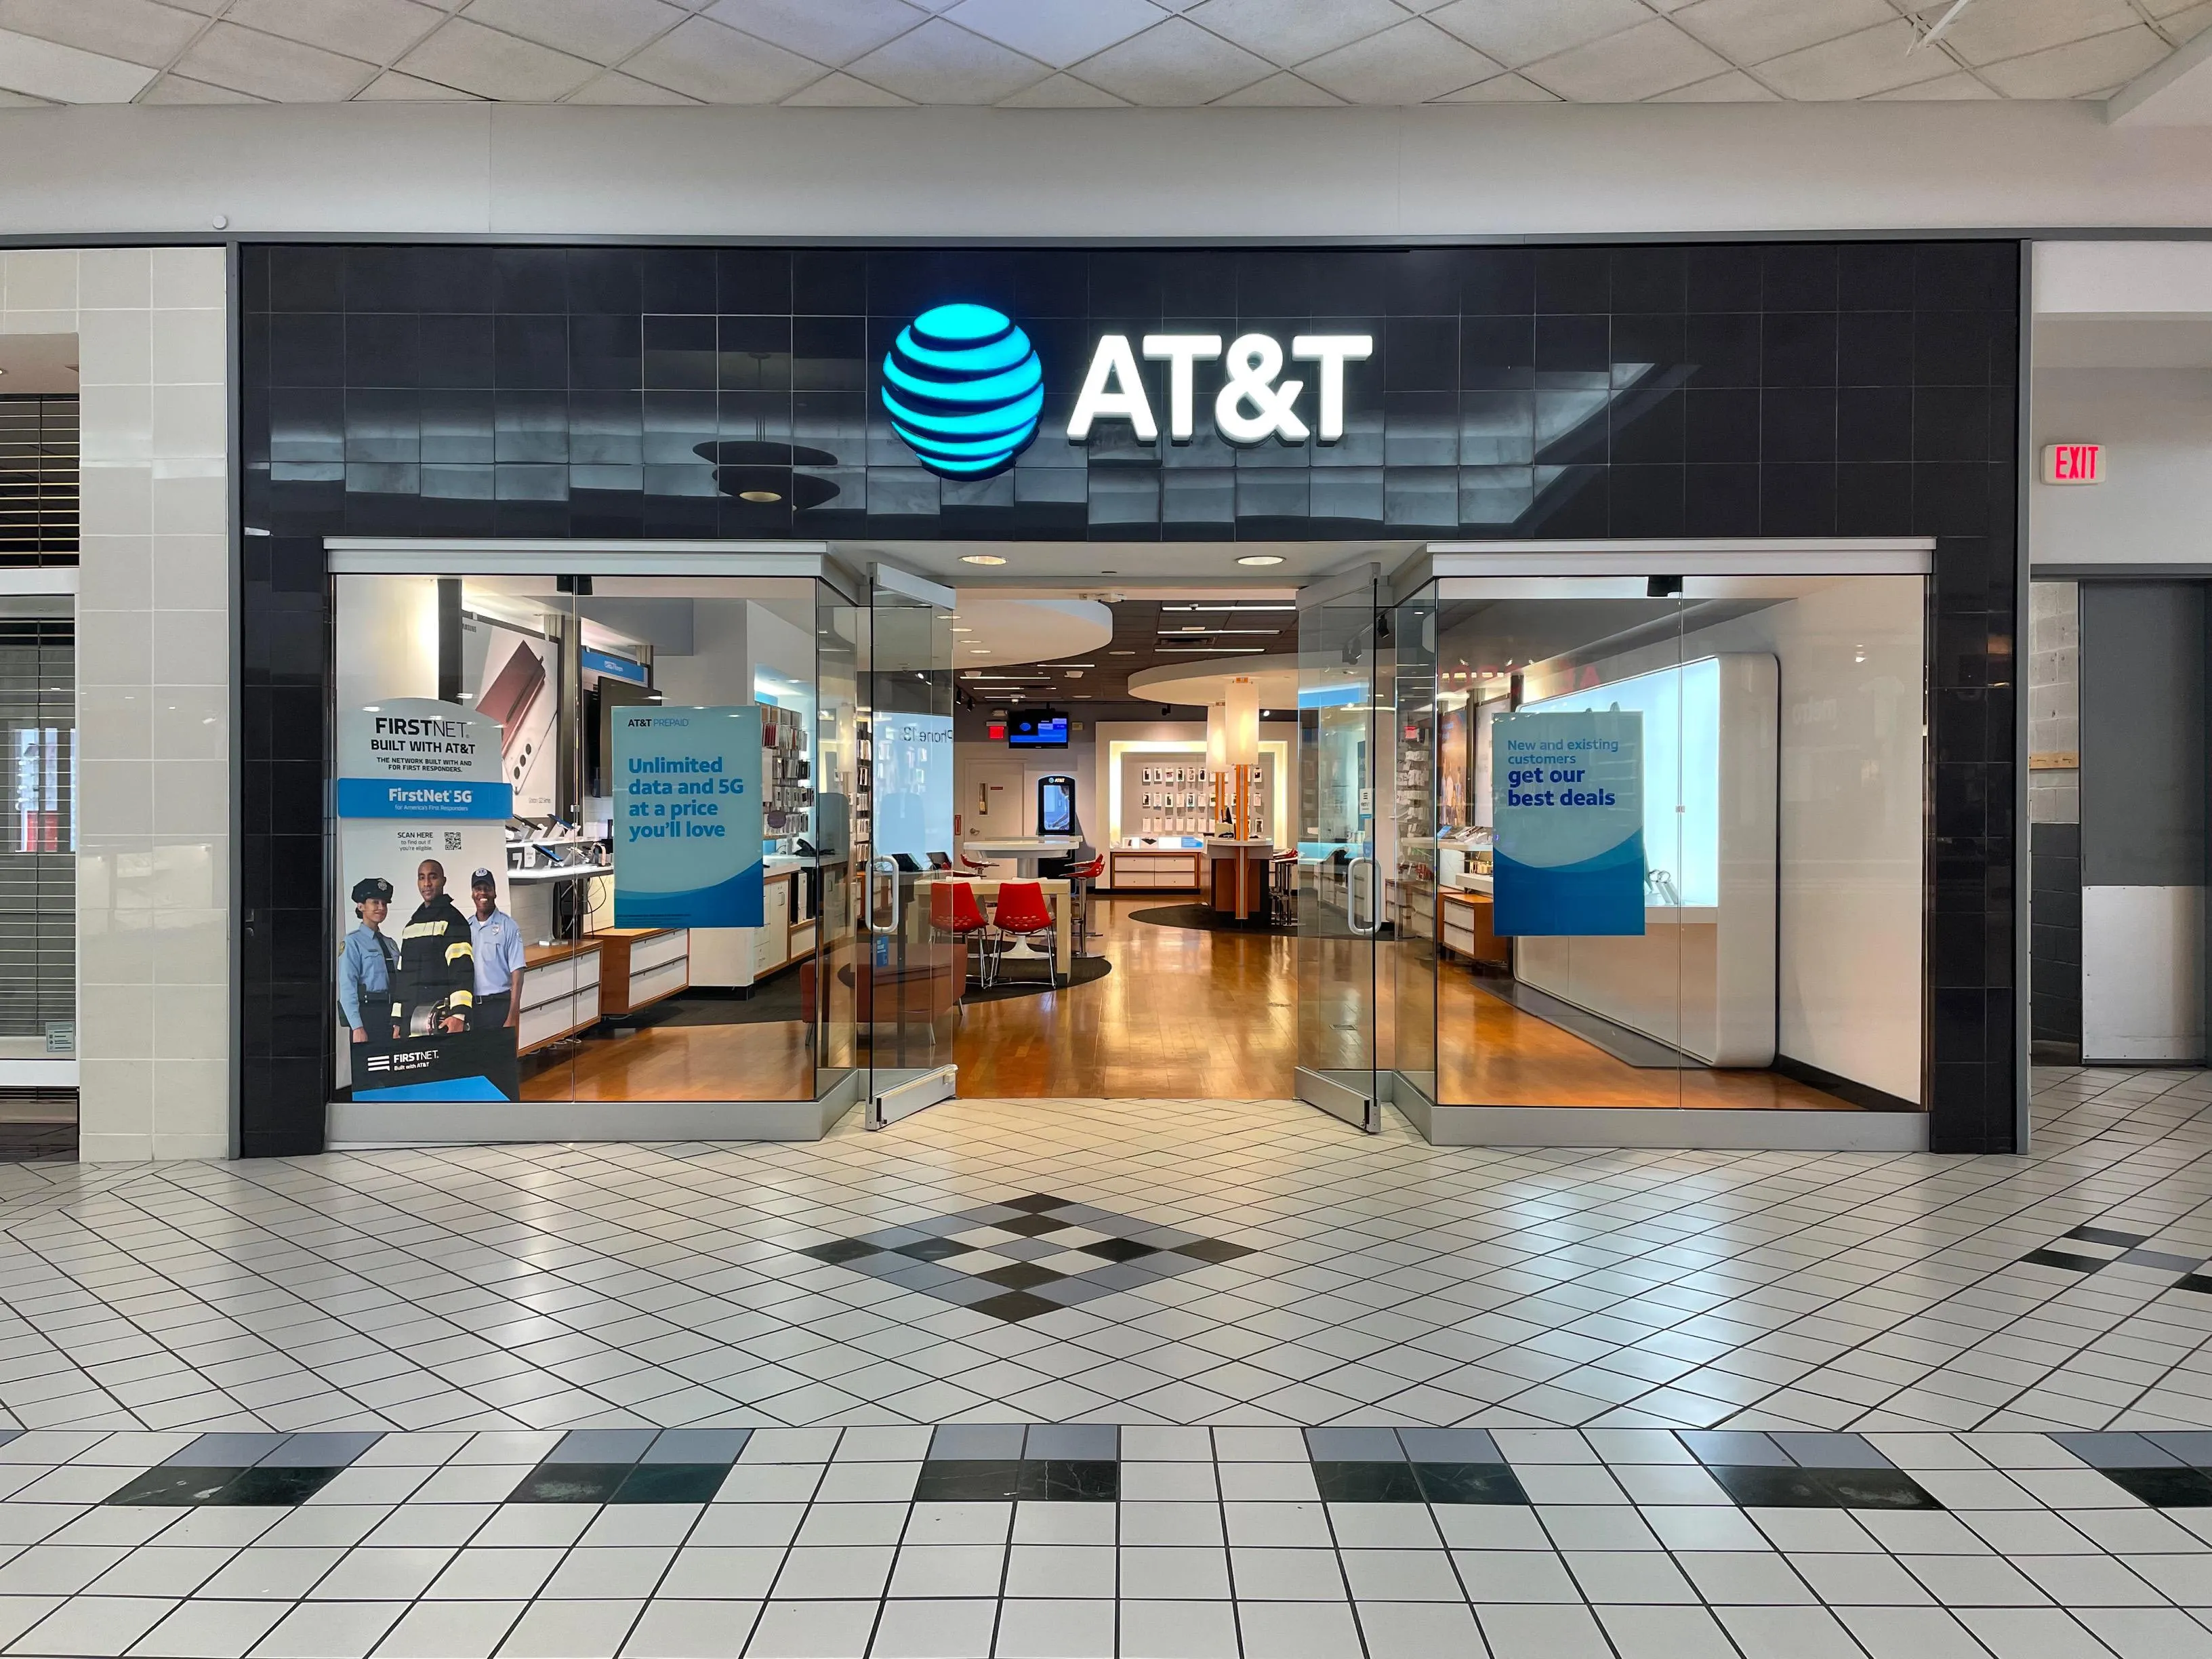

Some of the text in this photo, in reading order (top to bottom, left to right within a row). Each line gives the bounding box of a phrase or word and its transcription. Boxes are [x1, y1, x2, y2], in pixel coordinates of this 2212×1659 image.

[1066, 333, 1374, 445] AT&T
[2055, 445, 2100, 480] EXIT
[628, 718, 689, 727] AT&T PREPAID
[371, 739, 476, 754] BUILT WITH AT&T
[1507, 738, 1619, 752] New and existing
[628, 756, 722, 774] Unlimited
[1508, 754, 1576, 764] customers
[628, 778, 744, 795] data and 5G
[1508, 767, 1586, 788] get our
[453, 790, 472, 803] 5G
[1508, 788, 1616, 806] best deals
[629, 800, 718, 821] at a price
[629, 821, 726, 842] you'll love
